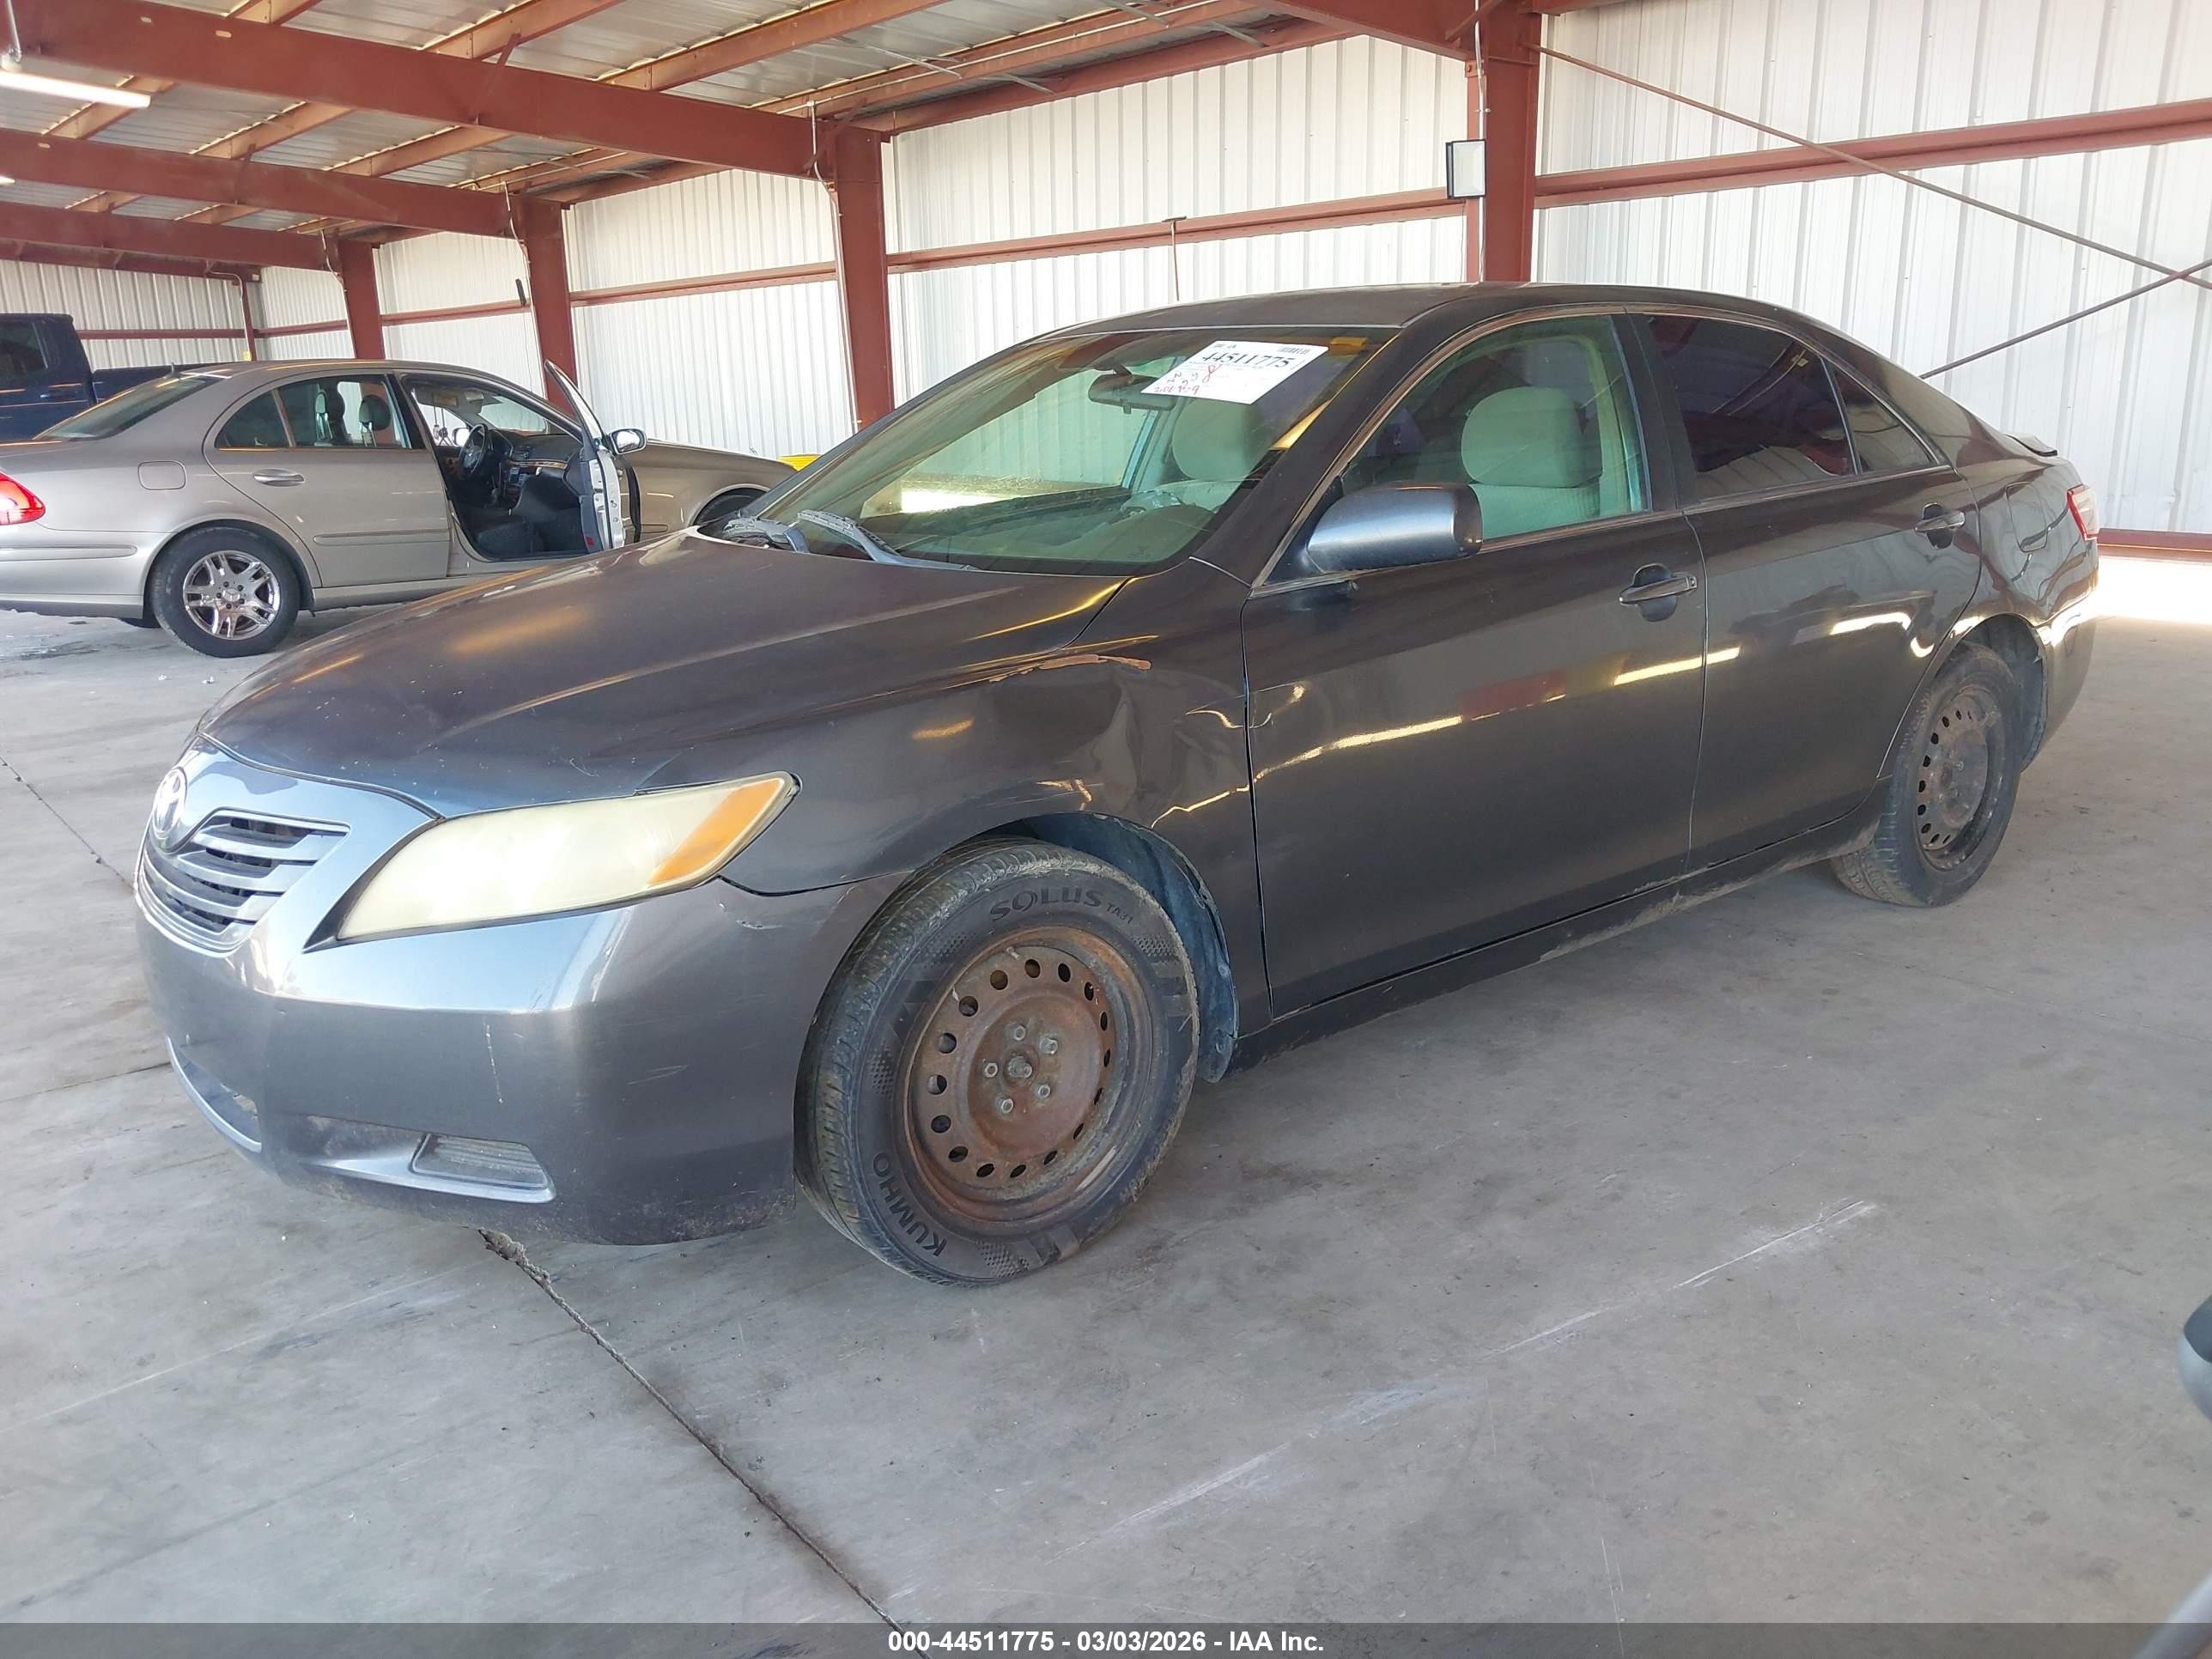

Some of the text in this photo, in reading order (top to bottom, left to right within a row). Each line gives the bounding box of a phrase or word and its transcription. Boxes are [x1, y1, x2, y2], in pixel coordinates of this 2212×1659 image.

[1201, 351, 1297, 368] 44511775
[989, 886, 1133, 925] SOLUS TA31
[872, 1152, 948, 1257] KUMHO
